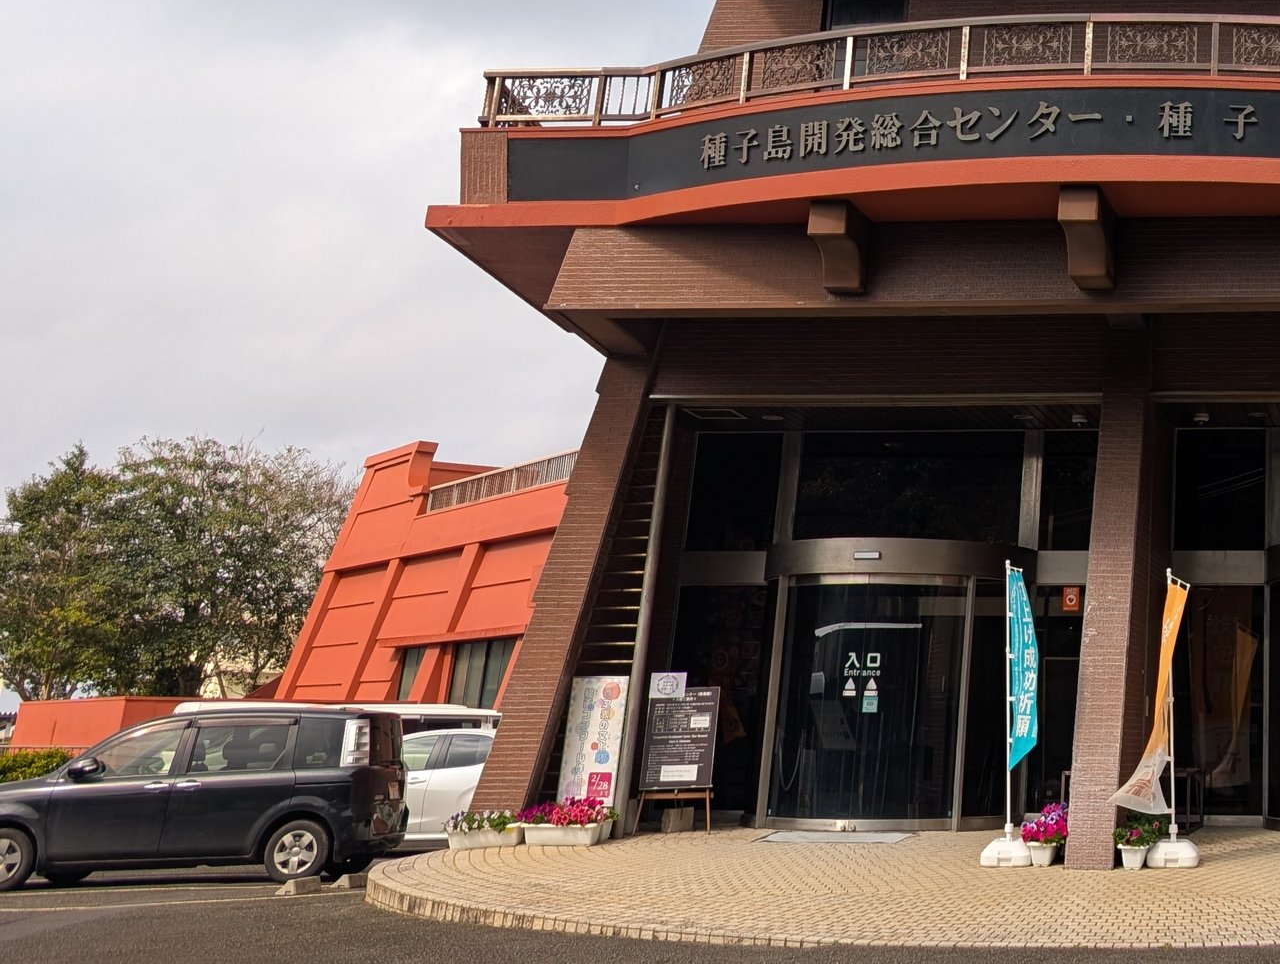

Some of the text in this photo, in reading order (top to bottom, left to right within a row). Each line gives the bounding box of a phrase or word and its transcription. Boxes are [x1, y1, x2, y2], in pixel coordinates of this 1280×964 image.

[845, 652, 881, 668] 入口
[843, 668, 881, 677] Entrance
[591, 773, 609, 790] 2/28
